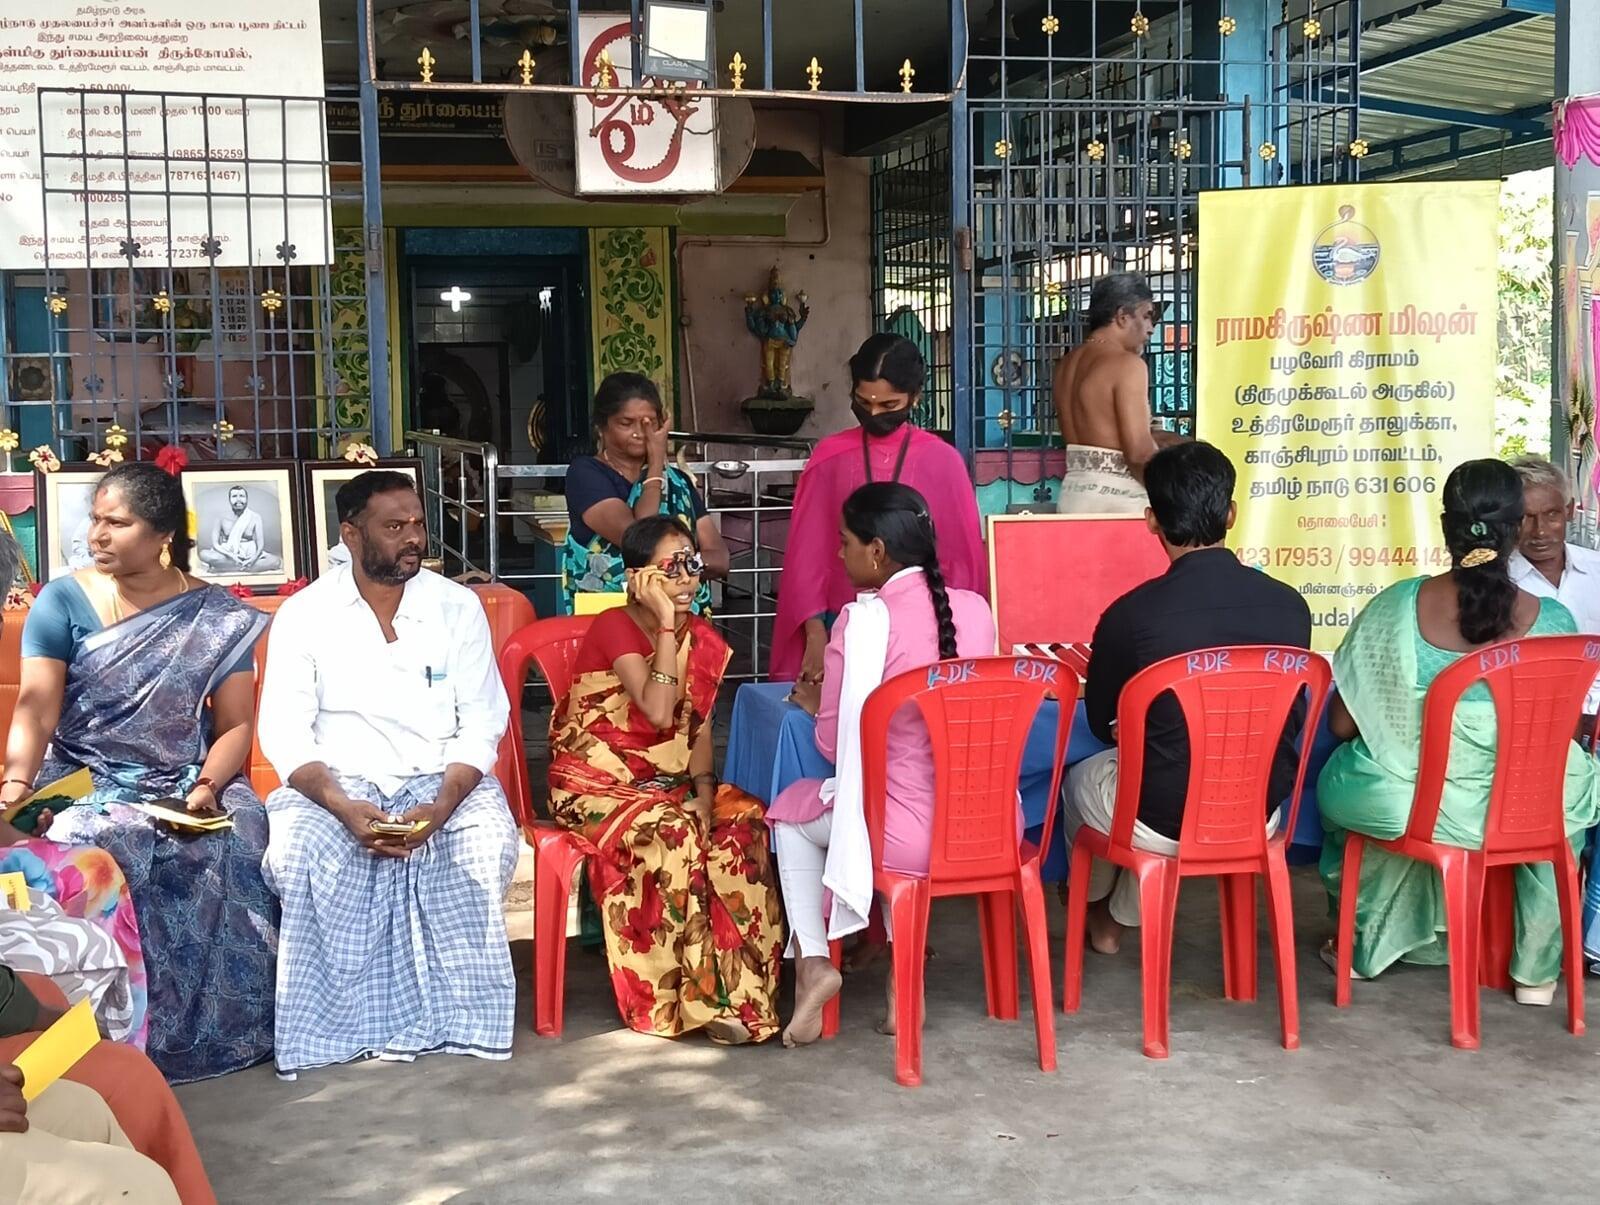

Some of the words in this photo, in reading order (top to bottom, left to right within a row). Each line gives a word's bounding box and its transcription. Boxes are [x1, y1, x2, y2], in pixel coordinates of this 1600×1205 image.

[1215, 305, 1383, 347] ராமகிருஷ்ண
[1389, 302, 1478, 343] மிஷன்
[1270, 350, 1343, 375] பழவேரி
[1349, 348, 1419, 371] கிராமம்
[1235, 382, 1368, 406] (திருமுக்கூடல்
[1371, 380, 1455, 402] அருகில்)
[1232, 413, 1355, 437] உத்திரமேரூர்
[1359, 412, 1458, 437] தாலுக்கா,
[1245, 444, 1348, 468] காஞ்சிபுரம்
[1353, 444, 1443, 464] மாவட்டம்,
[1249, 476, 1302, 501] தமிழ்
[1306, 477, 1349, 498] நாடு
[1354, 477, 1388, 494] 631
[1393, 476, 1436, 494] 606
[1311, 606, 1355, 627] udal
[1014, 658, 1058, 685] RDR
[1186, 650, 1232, 675] RDR
